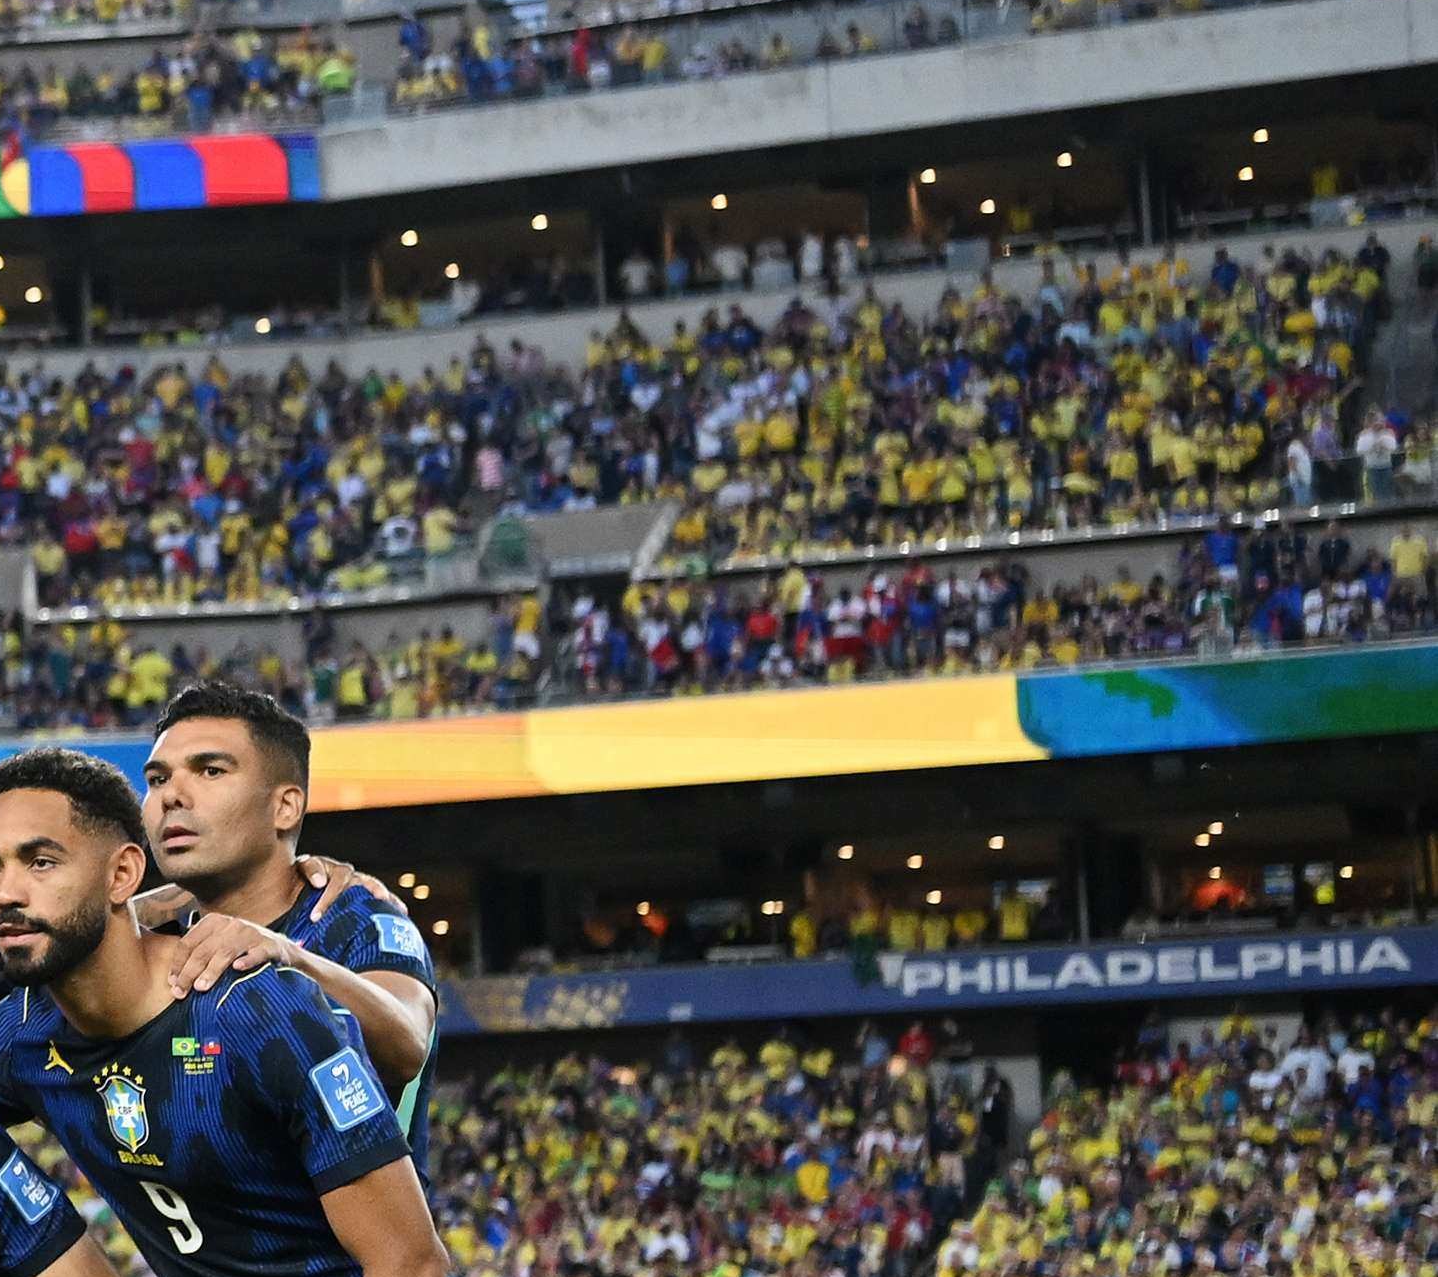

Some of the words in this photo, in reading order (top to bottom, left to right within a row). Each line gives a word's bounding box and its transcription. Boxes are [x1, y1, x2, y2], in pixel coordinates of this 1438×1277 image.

[902, 937, 1411, 997] PHILADELPHIA
[117, 1150, 165, 1166] BRASIL
[139, 1180, 204, 1254] 9
